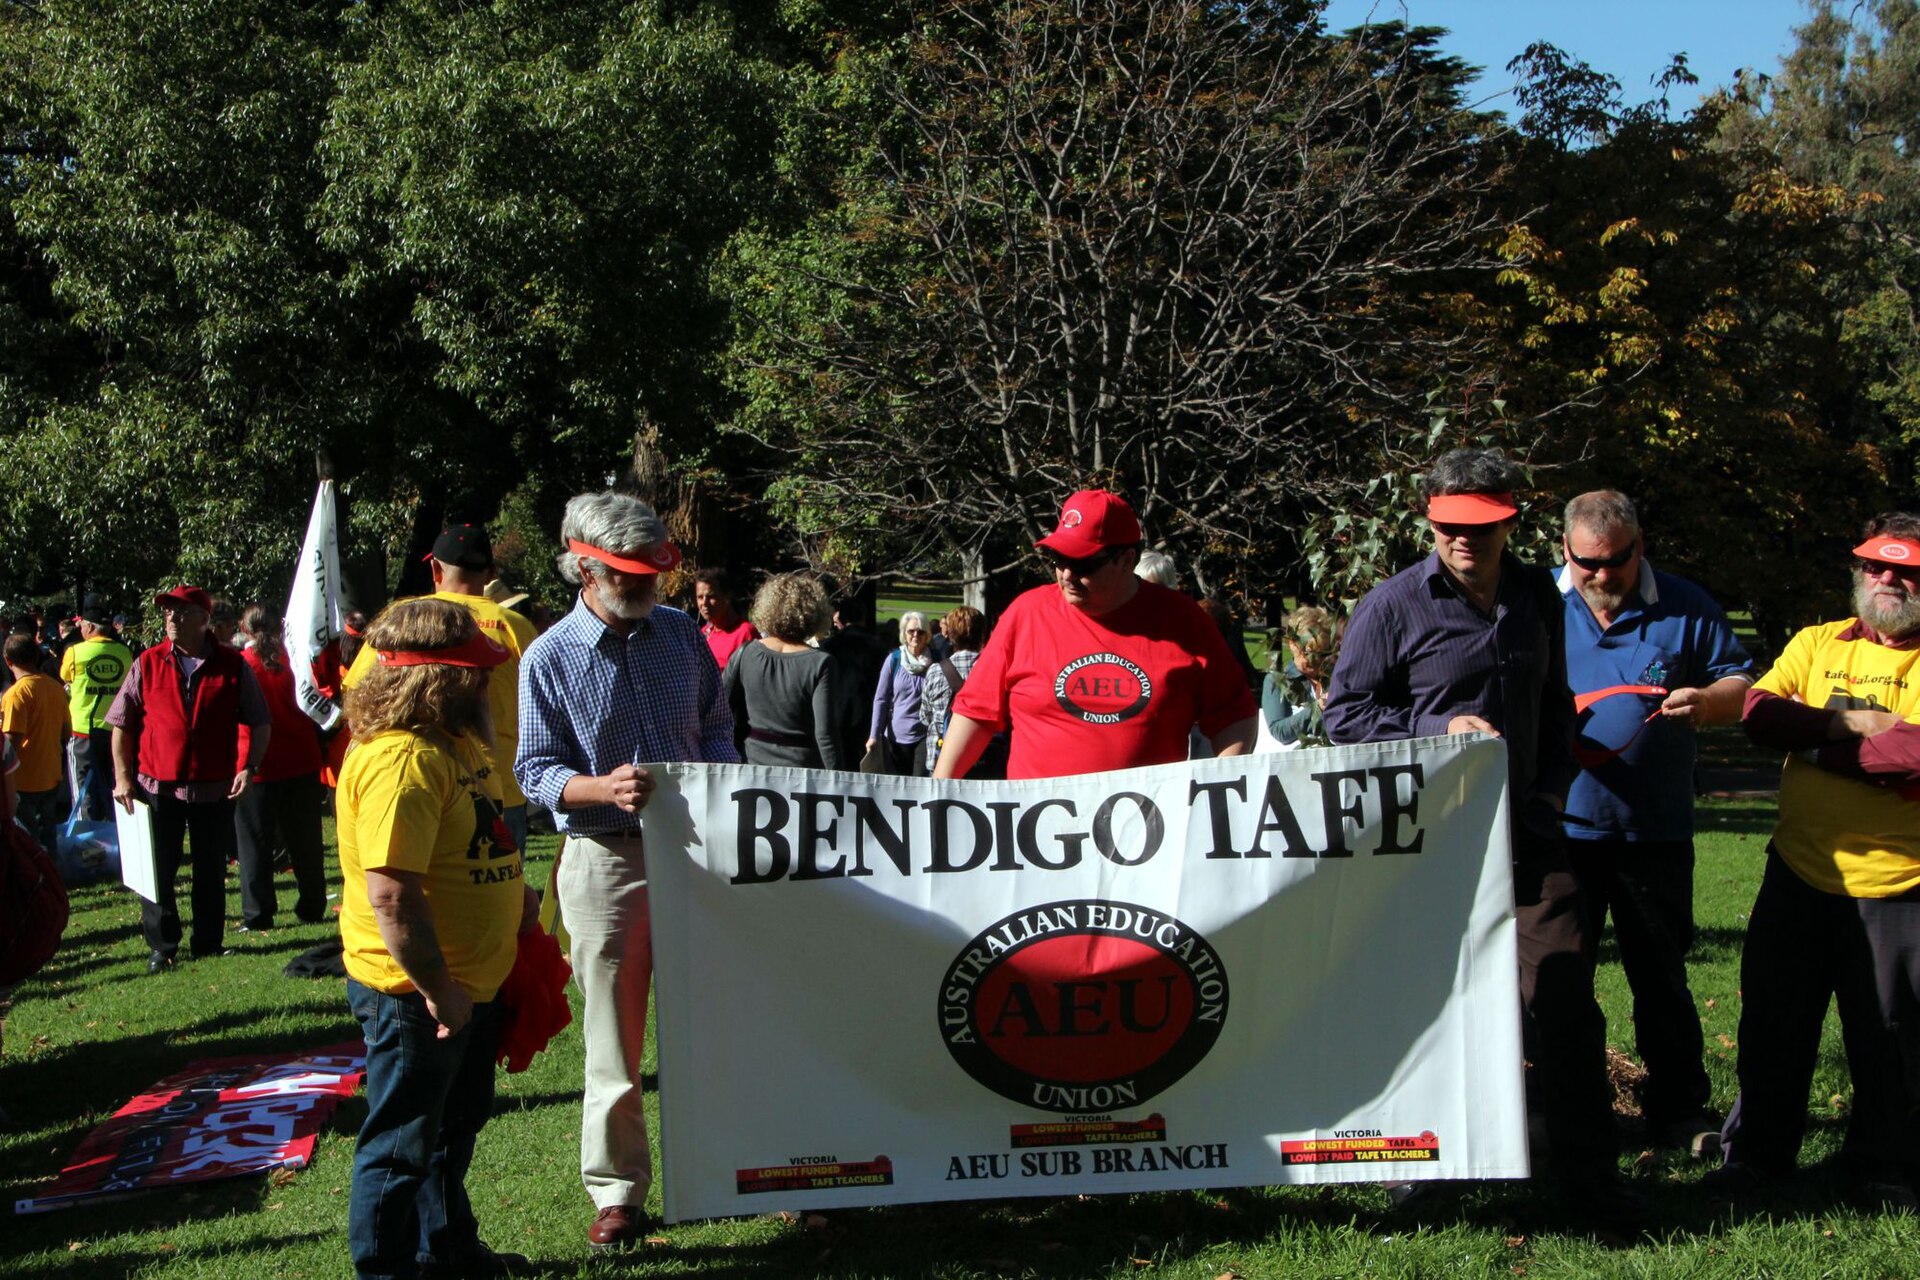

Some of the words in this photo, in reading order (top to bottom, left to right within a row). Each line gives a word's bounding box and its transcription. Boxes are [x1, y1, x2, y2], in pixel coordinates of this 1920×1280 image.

[92, 664, 119, 673] AEU
[1055, 653, 1102, 698] AUSTRALIAN
[1104, 653, 1151, 698] EDUCATION
[1070, 676, 1134, 698] AEU
[1082, 711, 1120, 723] UNION
[729, 787, 1165, 885] BENDIGO
[1188, 763, 1426, 860] TAFE
[944, 905, 1077, 1044] AUSTRALIAN
[1086, 904, 1224, 1023] EDUCATION
[987, 975, 1178, 1037] AEU
[1032, 1080, 1138, 1109] UNION
[1064, 1114, 1112, 1123] VICTORIA
[1033, 1124, 1073, 1134] LOWEST
[1074, 1123, 1115, 1132] FUNDED
[1334, 1129, 1382, 1138] VICTORIA
[1085, 1133, 1108, 1142] TAFE
[1110, 1131, 1158, 1142] TEACHERS
[1303, 1140, 1343, 1150] LOWEST
[1345, 1139, 1385, 1149] FUNDED
[789, 1155, 838, 1165] VICTORIA
[945, 1153, 1010, 1181] AEU
[1021, 1150, 1082, 1177] SUB
[1092, 1143, 1229, 1174] BRANCH
[1290, 1152, 1330, 1163] LOWEST
[1331, 1151, 1354, 1161] PAID
[1355, 1150, 1380, 1160] TAFE
[1380, 1149, 1431, 1160] TEACHERS
[758, 1167, 798, 1178] LOWEST
[801, 1165, 840, 1177] FUNDED
[811, 1177, 835, 1187] TAFE
[836, 1174, 885, 1186] TEACHERS
